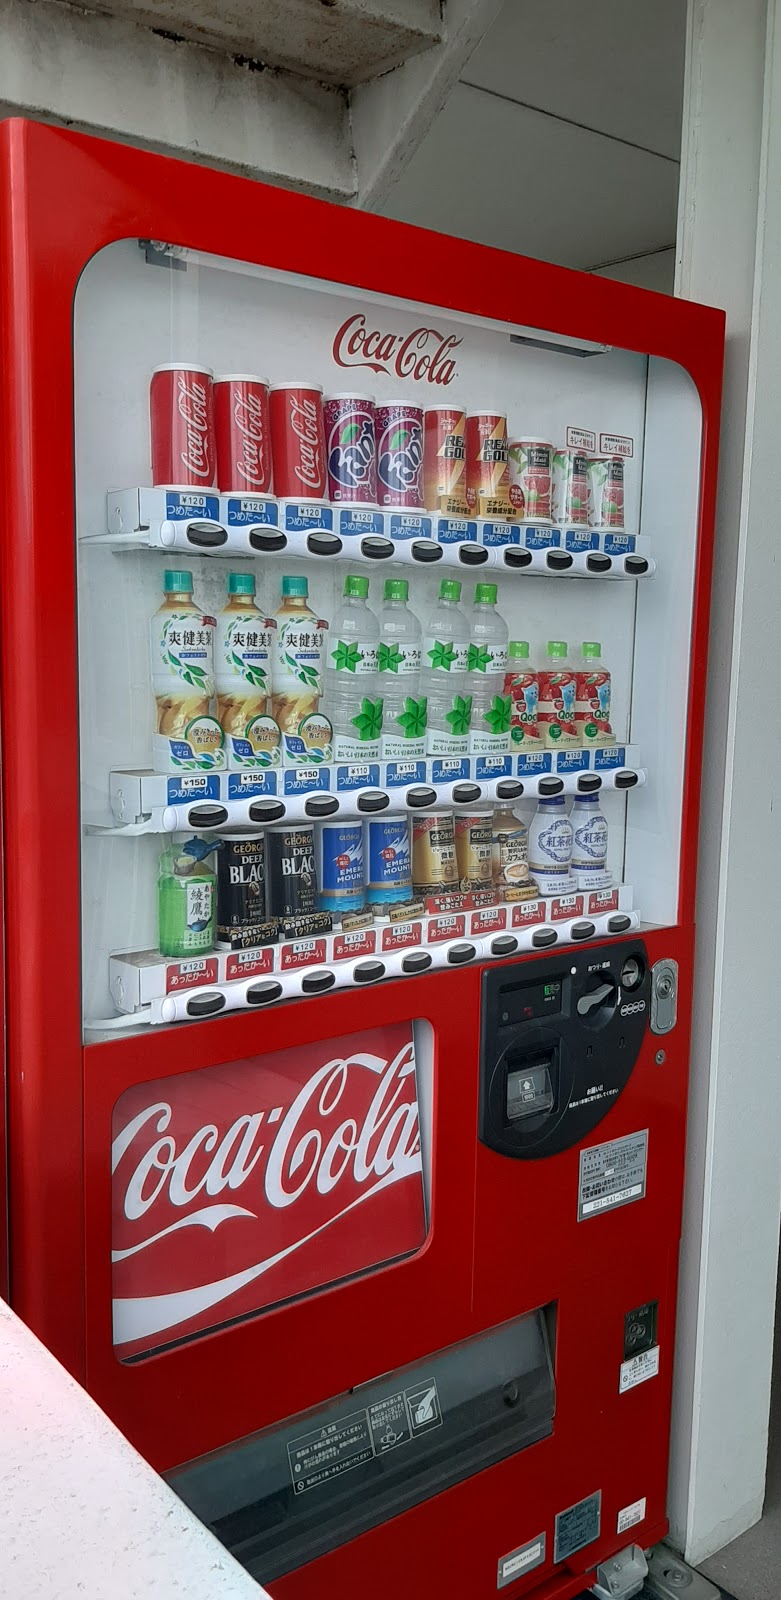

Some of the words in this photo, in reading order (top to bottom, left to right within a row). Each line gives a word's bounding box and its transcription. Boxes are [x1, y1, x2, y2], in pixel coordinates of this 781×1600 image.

[333, 313, 463, 385] Coca-Cola
[178, 375, 209, 477] Coca-Cola
[234, 389, 264, 486] Coca-Cola
[290, 395, 321, 488] Coca-Cola
[181, 495, 204, 505] ¥120
[243, 502, 264, 511] ¥120
[300, 508, 320, 516] ¥120
[353, 513, 371, 521] ¥120
[403, 518, 420, 526] ¥120
[449, 522, 466, 530] ¥120
[168, 630, 212, 646] 爽健美茶
[299, 770, 318, 778] ¥150
[351, 767, 368, 775] ¥110
[184, 778, 205, 786] ¥150
[190, 887, 204, 916] 綾鷹
[562, 897, 574, 905] ¥130
[394, 926, 411, 934] ¥120
[346, 933, 364, 942] ¥120
[295, 942, 314, 951] ¥120
[241, 952, 260, 960] ¥120
[182, 962, 204, 971] ¥120
[112, 1042, 421, 1245] Coca-Cola
